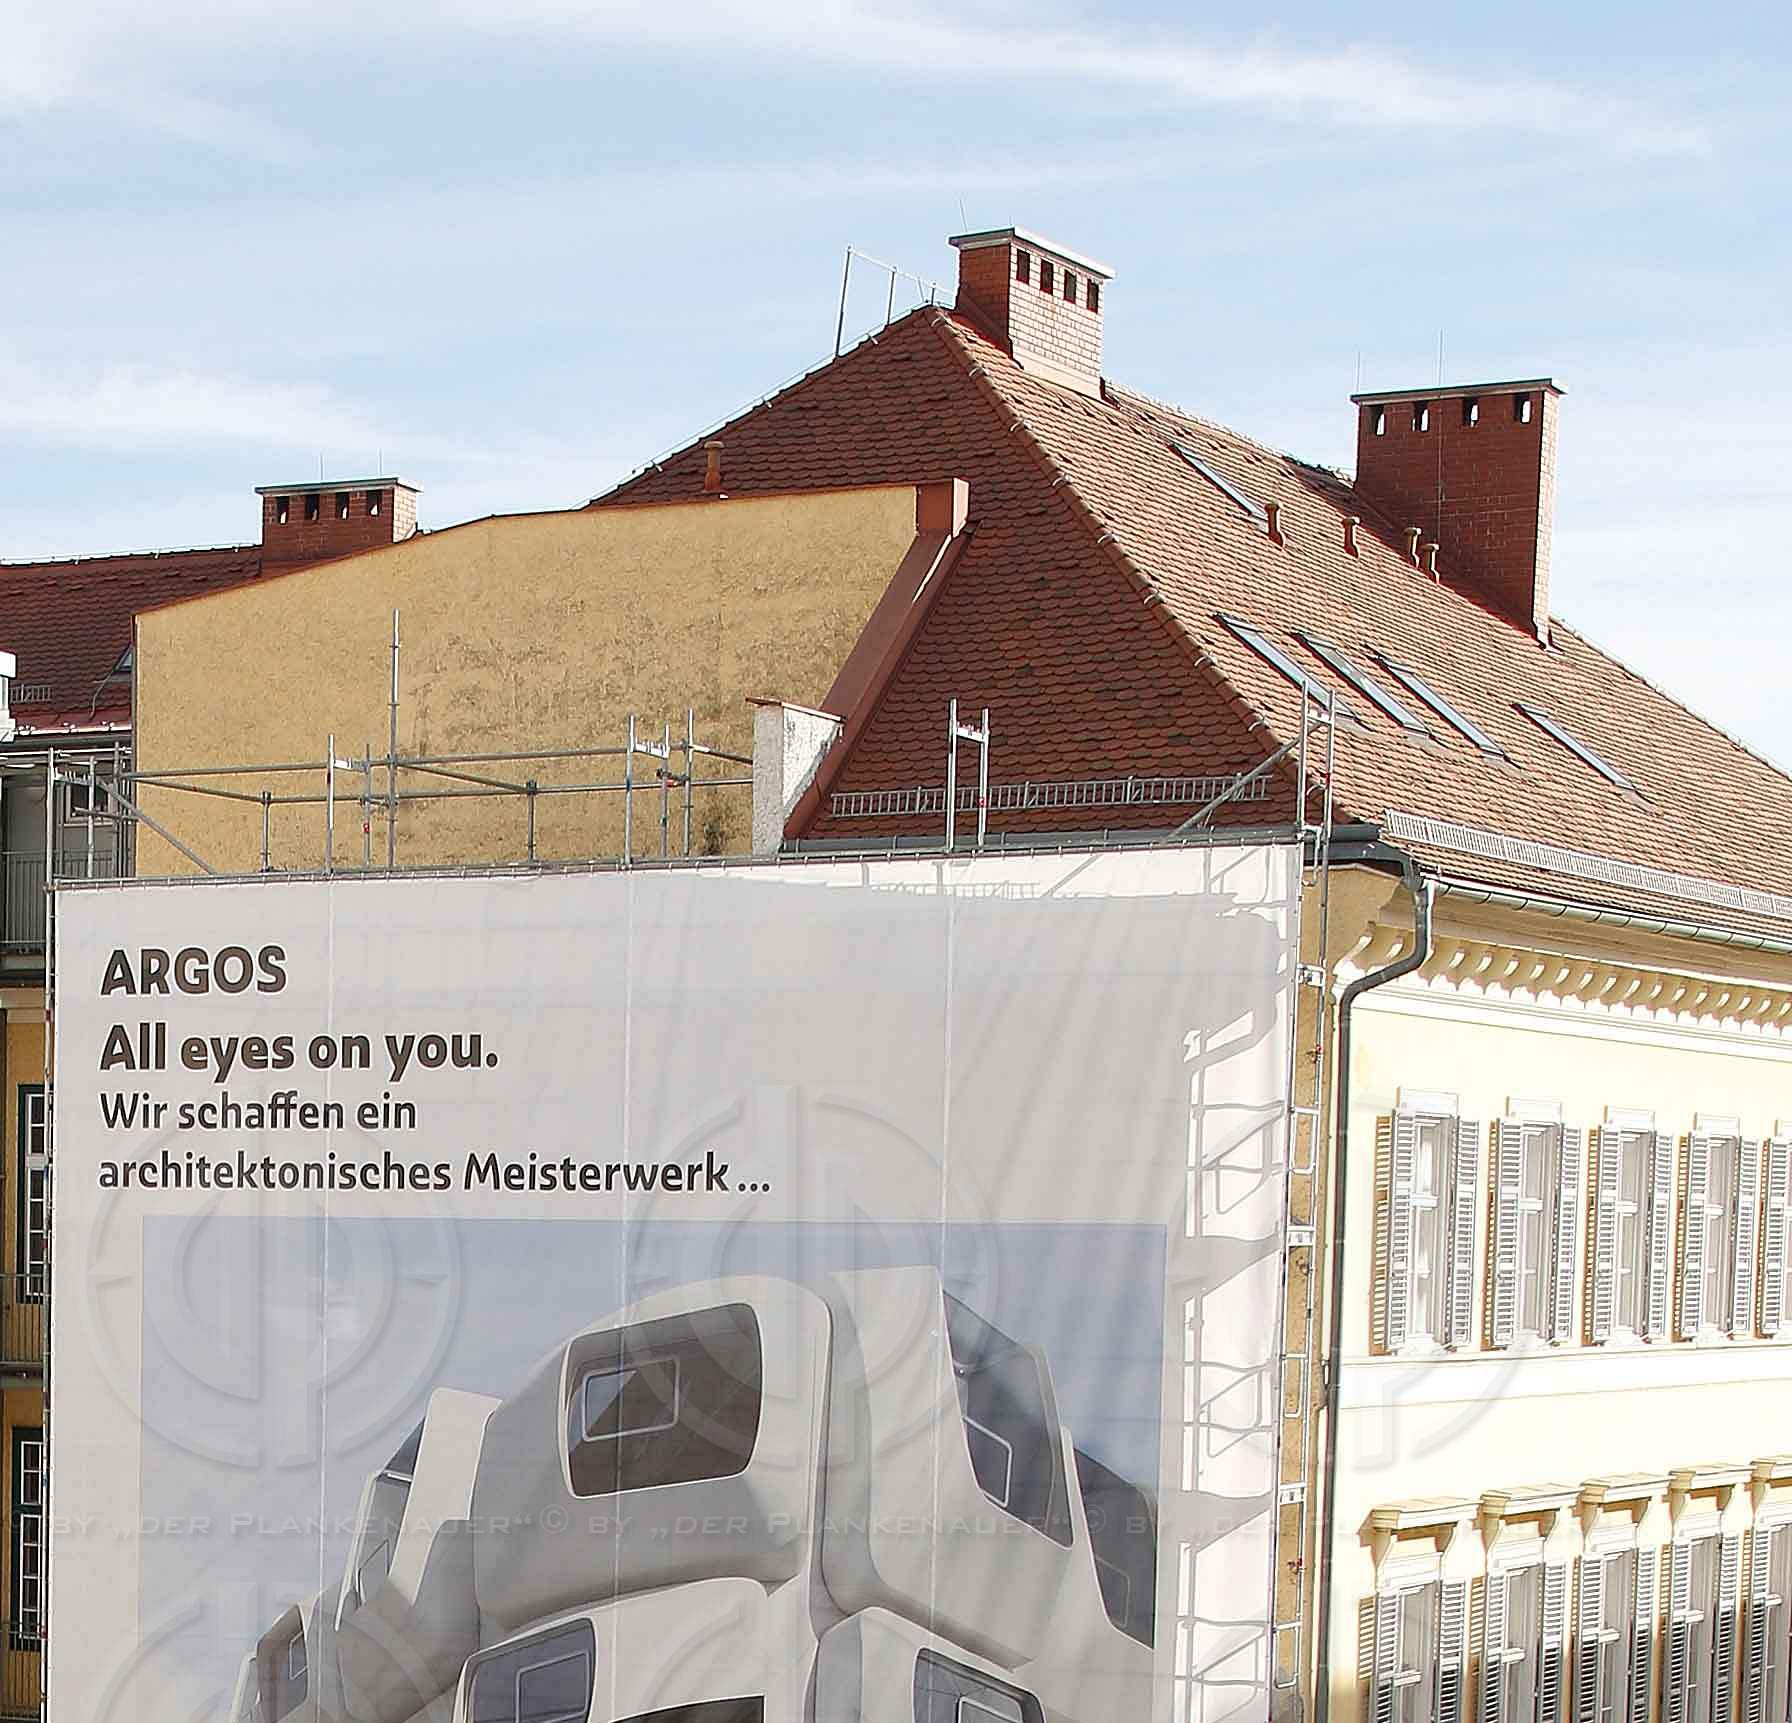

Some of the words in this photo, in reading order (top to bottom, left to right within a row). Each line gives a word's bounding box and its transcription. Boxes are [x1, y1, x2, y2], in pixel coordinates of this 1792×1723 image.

[100, 945, 287, 996] ARGOS
[99, 1022, 166, 1071] All
[180, 1035, 295, 1084] eyes
[308, 1035, 371, 1069] on
[384, 1034, 498, 1083] you.
[100, 1092, 168, 1129] Wir
[178, 1090, 344, 1130] schaffen
[357, 1091, 416, 1129] ein
[99, 1150, 451, 1191] architektonisches
